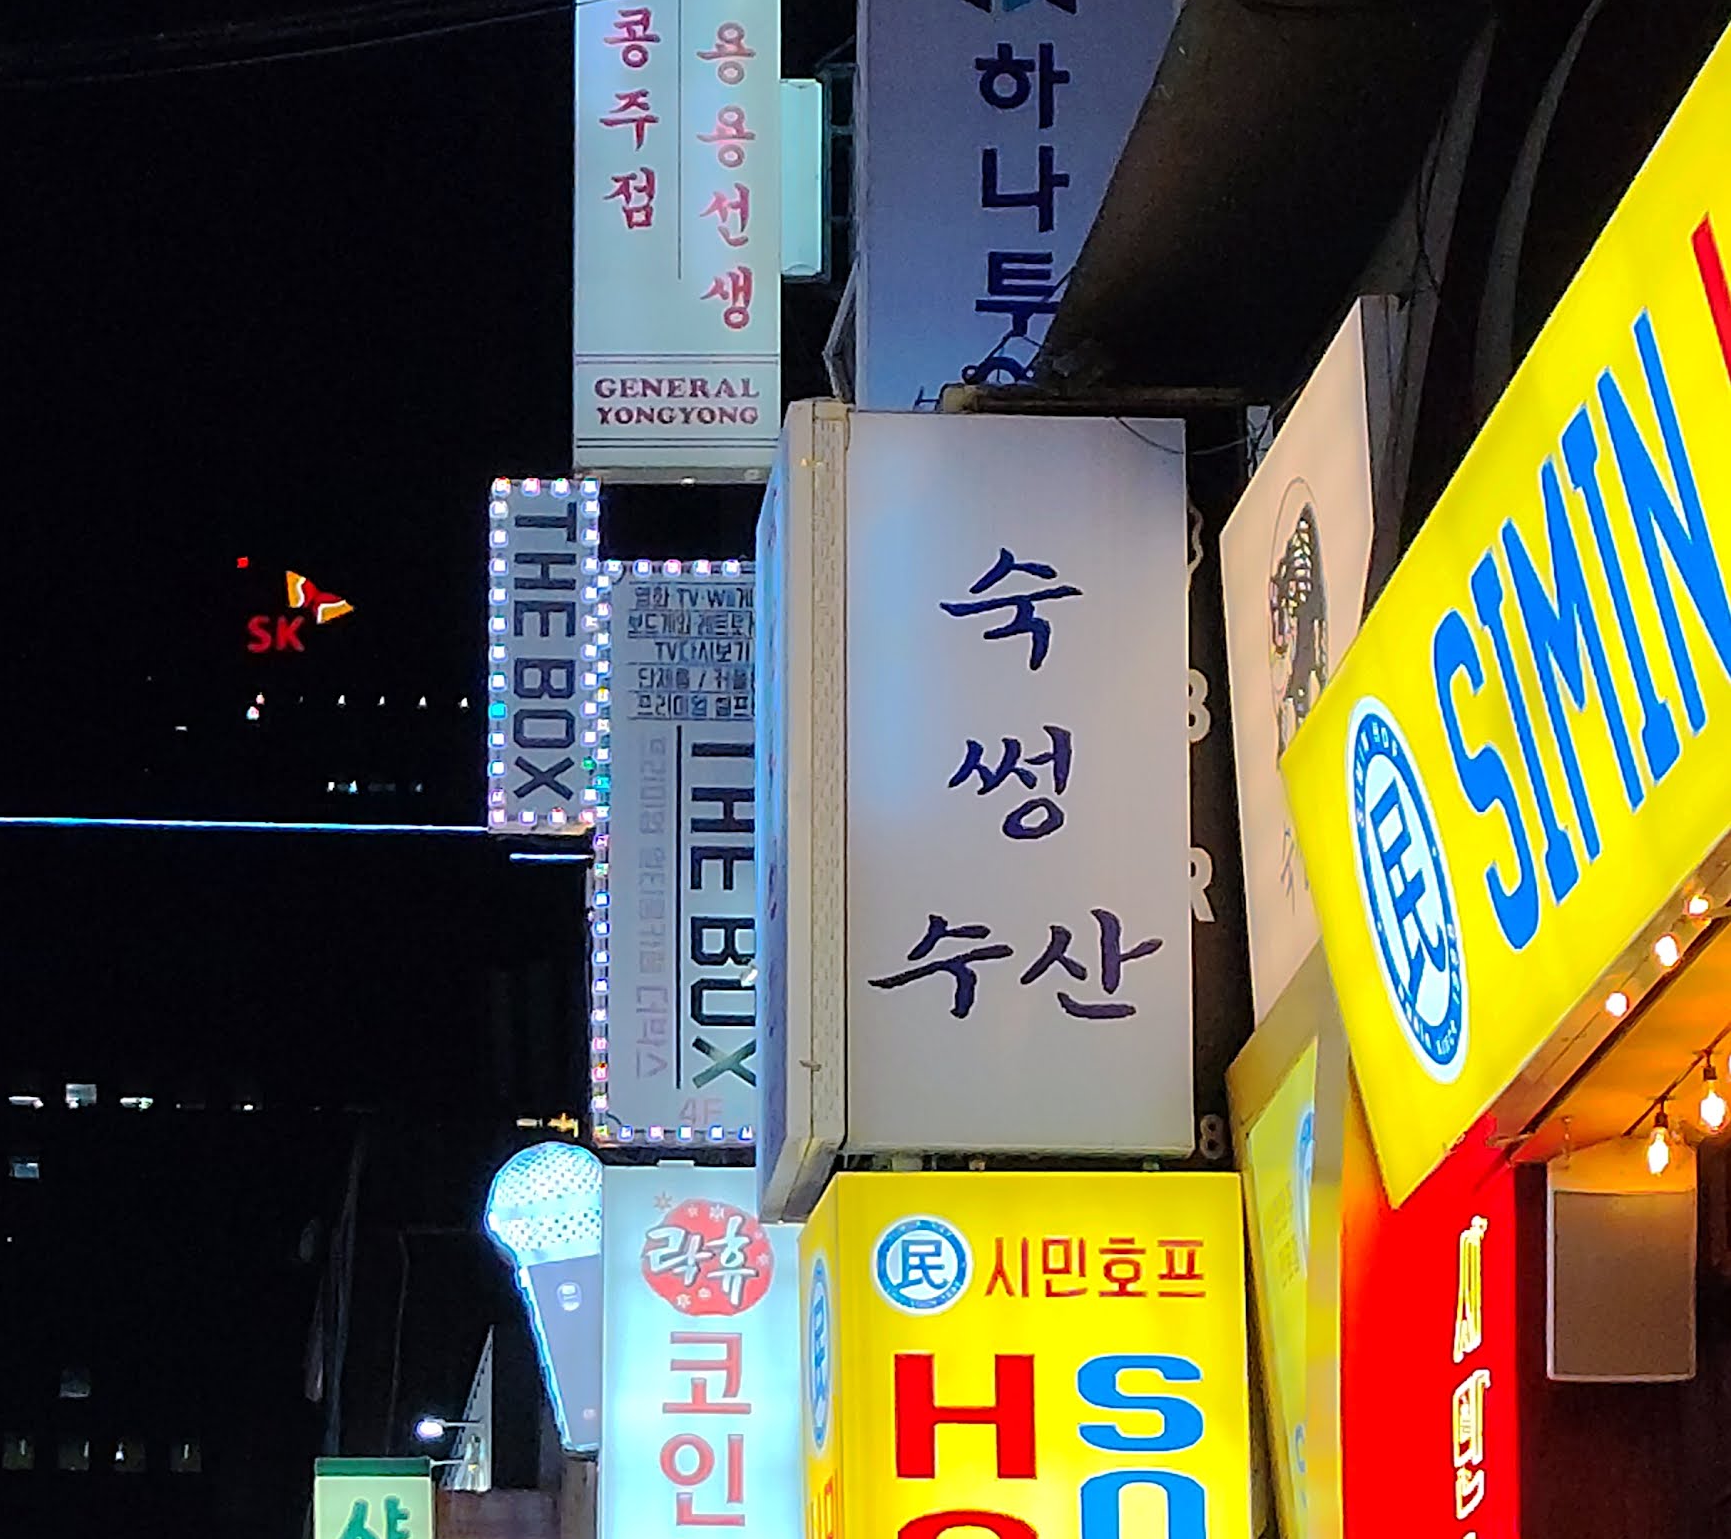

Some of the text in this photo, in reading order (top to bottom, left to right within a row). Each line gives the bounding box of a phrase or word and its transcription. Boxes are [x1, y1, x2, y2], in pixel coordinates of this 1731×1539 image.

[697, 20, 756, 331] 용용선생
[593, 376, 761, 399] GENERAL
[596, 404, 759, 426] YONGYONG
[247, 615, 305, 653] SK
[513, 504, 576, 800] THE BOX
[1431, 307, 1731, 954] SIMIN
[868, 908, 1163, 1019] 수산
[897, 1239, 950, 1291] 民
[983, 1236, 1206, 1299] 시민호프
